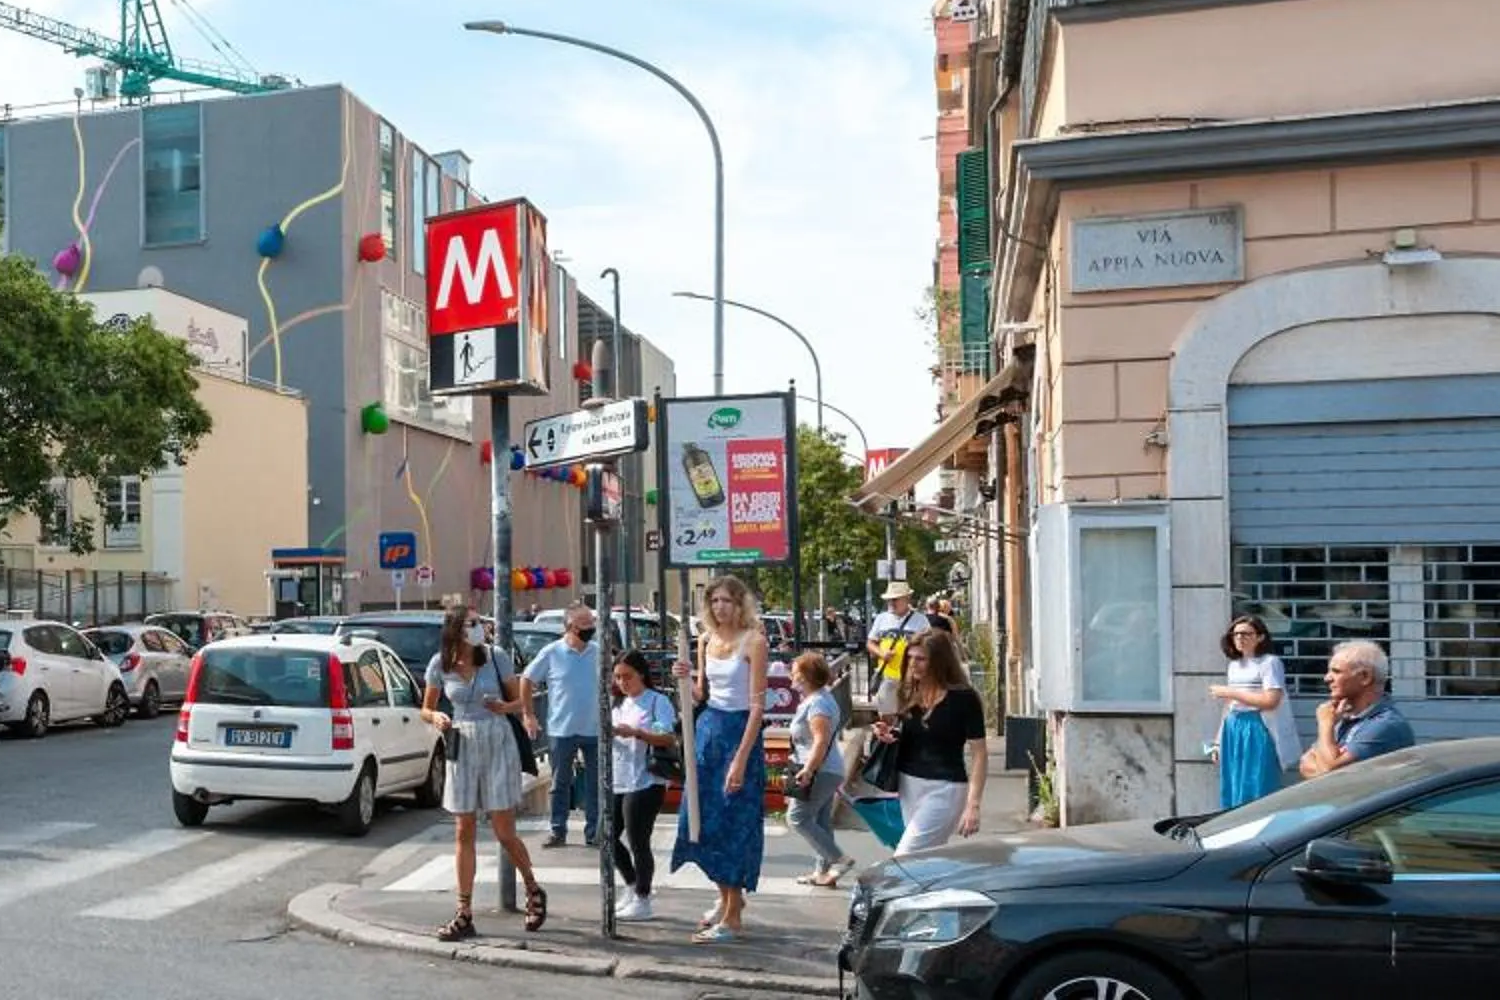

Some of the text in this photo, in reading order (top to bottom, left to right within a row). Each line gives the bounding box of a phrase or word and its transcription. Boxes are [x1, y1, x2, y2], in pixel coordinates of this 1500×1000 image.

[435, 228, 514, 310] M
[1088, 250, 1225, 272] APPIA NUOVA
